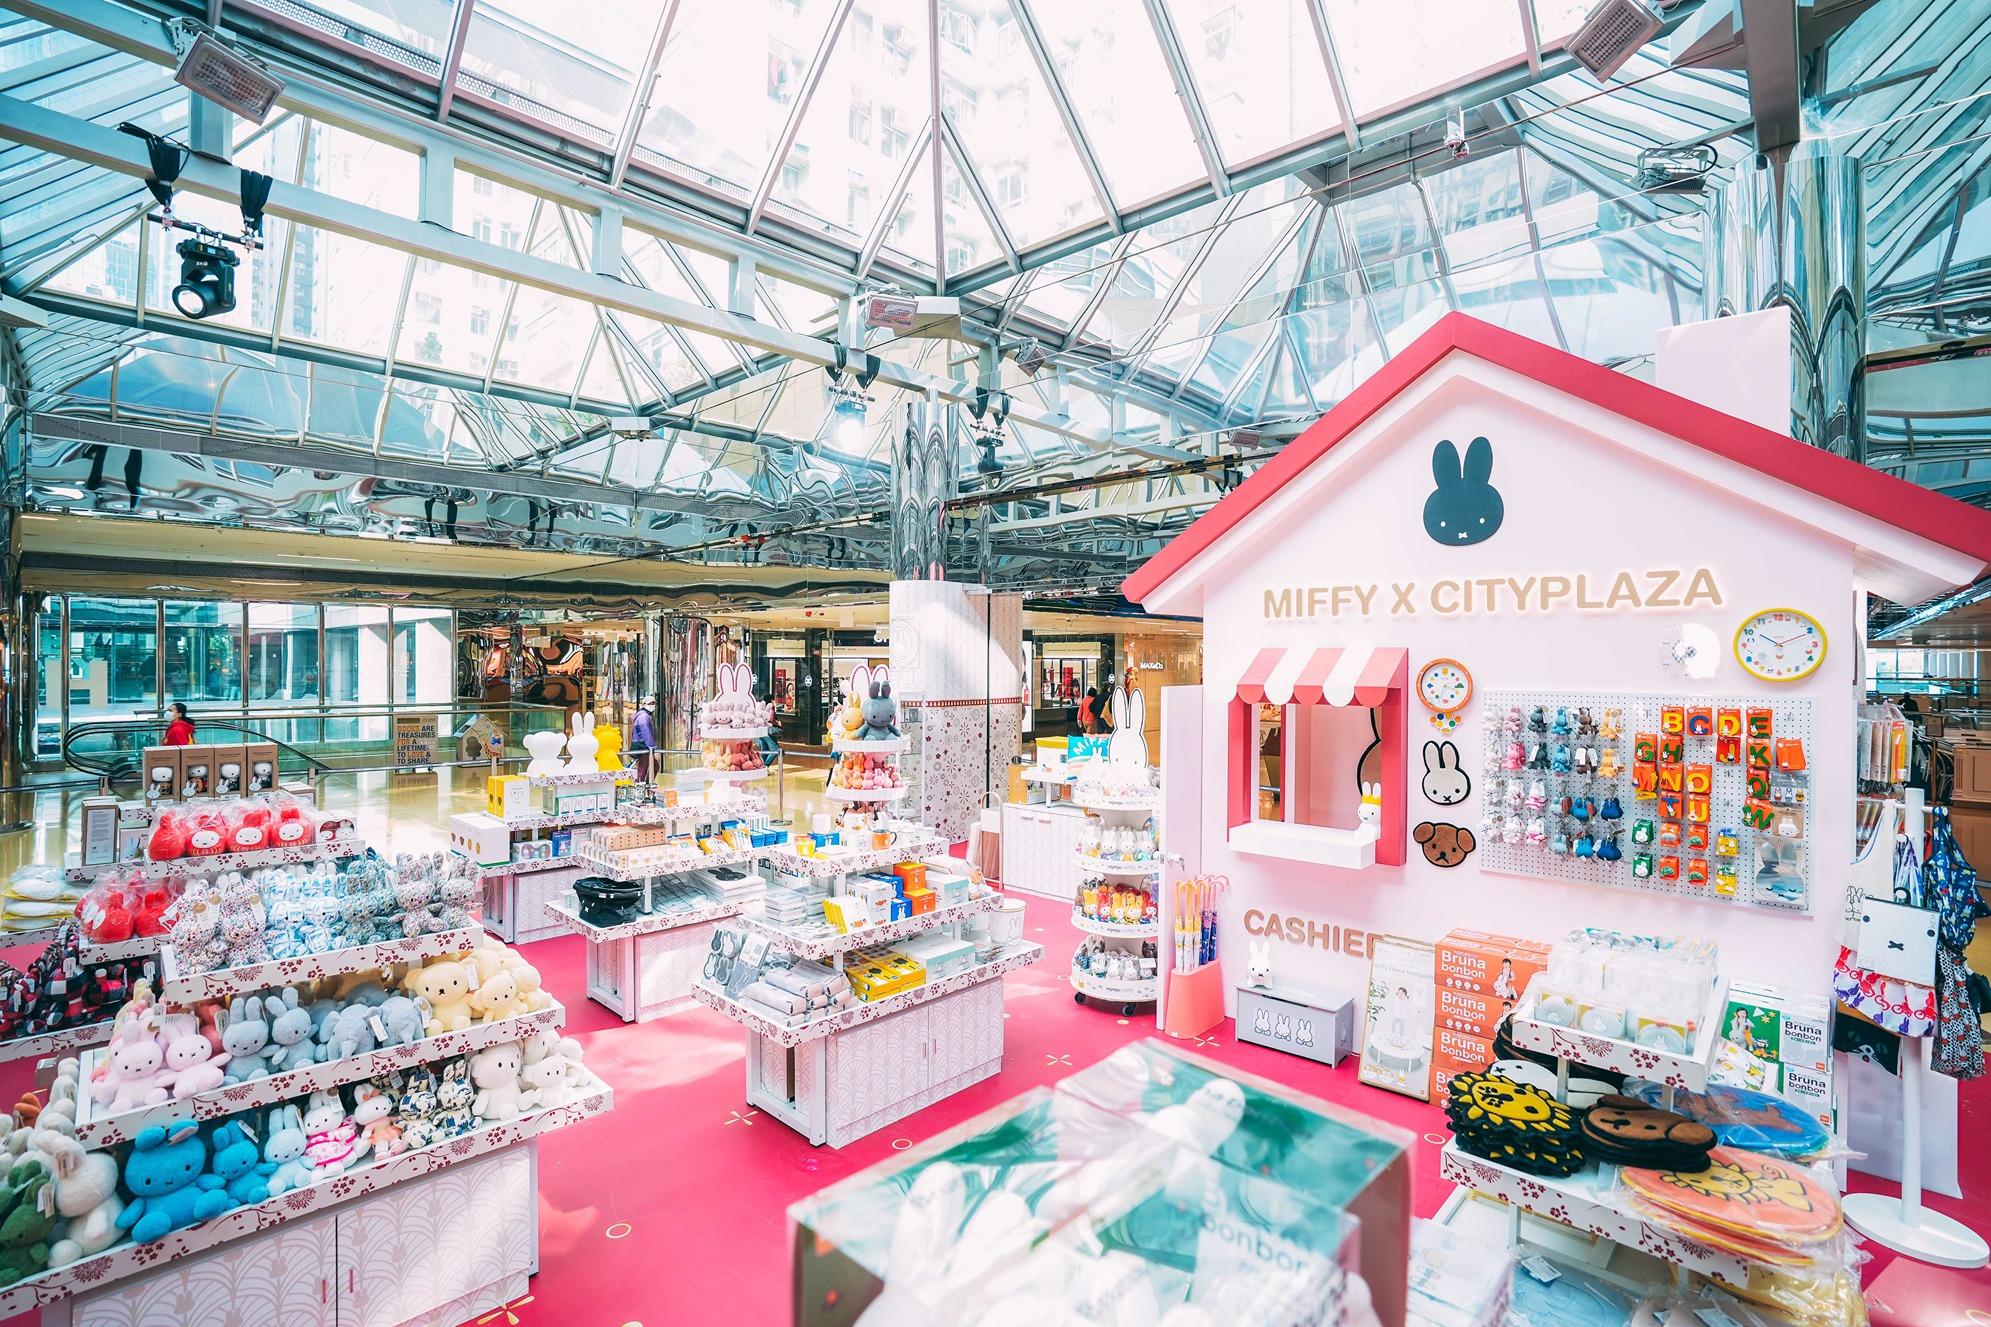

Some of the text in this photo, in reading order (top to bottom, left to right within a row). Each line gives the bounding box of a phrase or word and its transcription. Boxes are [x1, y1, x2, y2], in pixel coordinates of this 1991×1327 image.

[1264, 568, 1723, 618] MIFFY X CITYPLAZA
[1743, 628, 1754, 636] 10
[397, 725, 420, 733] BOOKS
[1663, 712, 1683, 733] B
[1689, 715, 1709, 735] C
[1718, 715, 1740, 737] D
[1750, 717, 1770, 738] E
[1073, 738, 1110, 755] MIFF
[1636, 741, 1653, 760] G
[1662, 743, 1681, 763] H
[1749, 745, 1770, 765] K
[1661, 770, 1682, 792] N
[1686, 772, 1709, 793] O
[1689, 802, 1707, 823] U
[1441, 949, 1486, 969] Bruna
[1441, 962, 1486, 979] bonbon
[1441, 991, 1486, 1011] Bruna
[1441, 1003, 1486, 1021] bonbon
[1784, 1029, 1822, 1042] bonbon
[1785, 1020, 1822, 1036] Bruna
[1441, 1032, 1486, 1053] Bruna
[1440, 1043, 1485, 1063] bonbon
[1788, 1080, 1826, 1095] bonbon
[1789, 1072, 1826, 1088] Bruna
